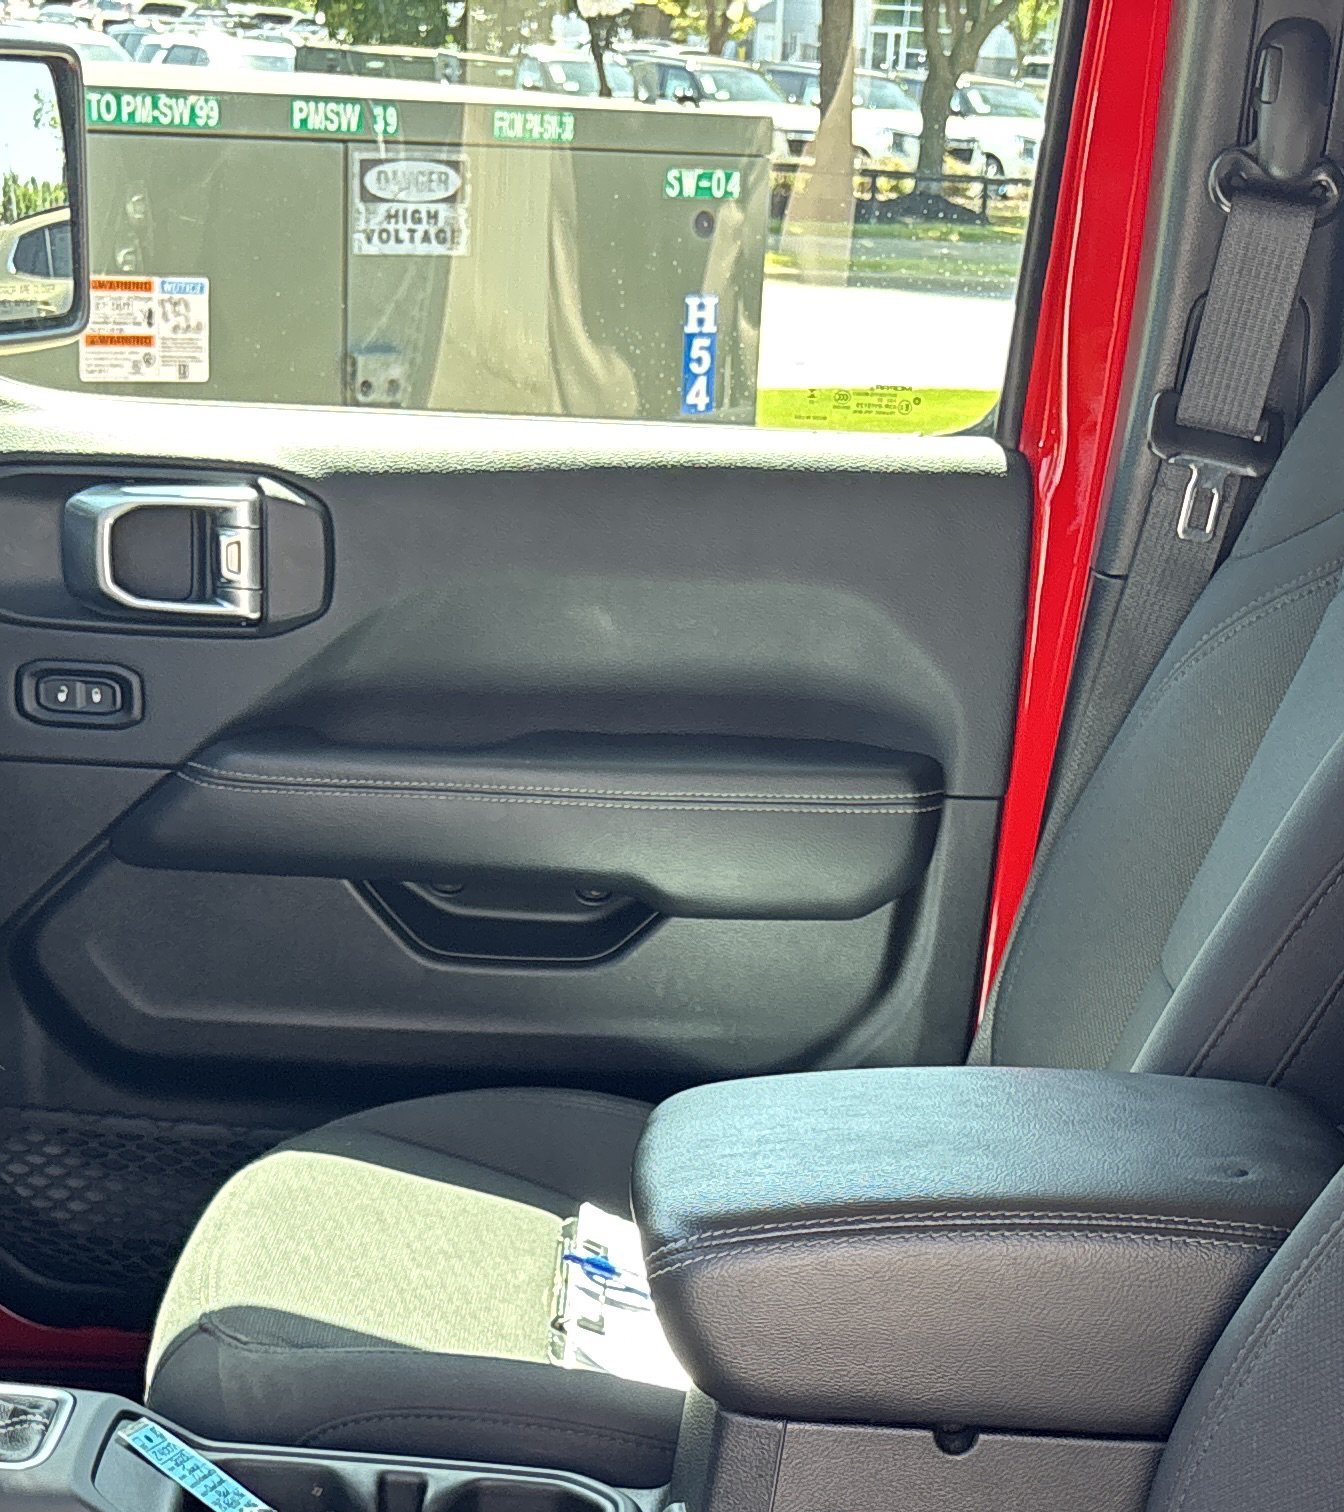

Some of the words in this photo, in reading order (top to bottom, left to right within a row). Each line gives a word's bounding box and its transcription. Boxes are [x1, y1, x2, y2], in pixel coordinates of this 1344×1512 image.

[86, 93, 117, 121] TO
[293, 101, 360, 132] PMSW
[373, 106, 397, 134] 39
[375, 170, 449, 192] DANGER
[666, 169, 740, 198] SW-04
[386, 209, 439, 225] HIGH
[364, 227, 460, 245] VOLTAGE
